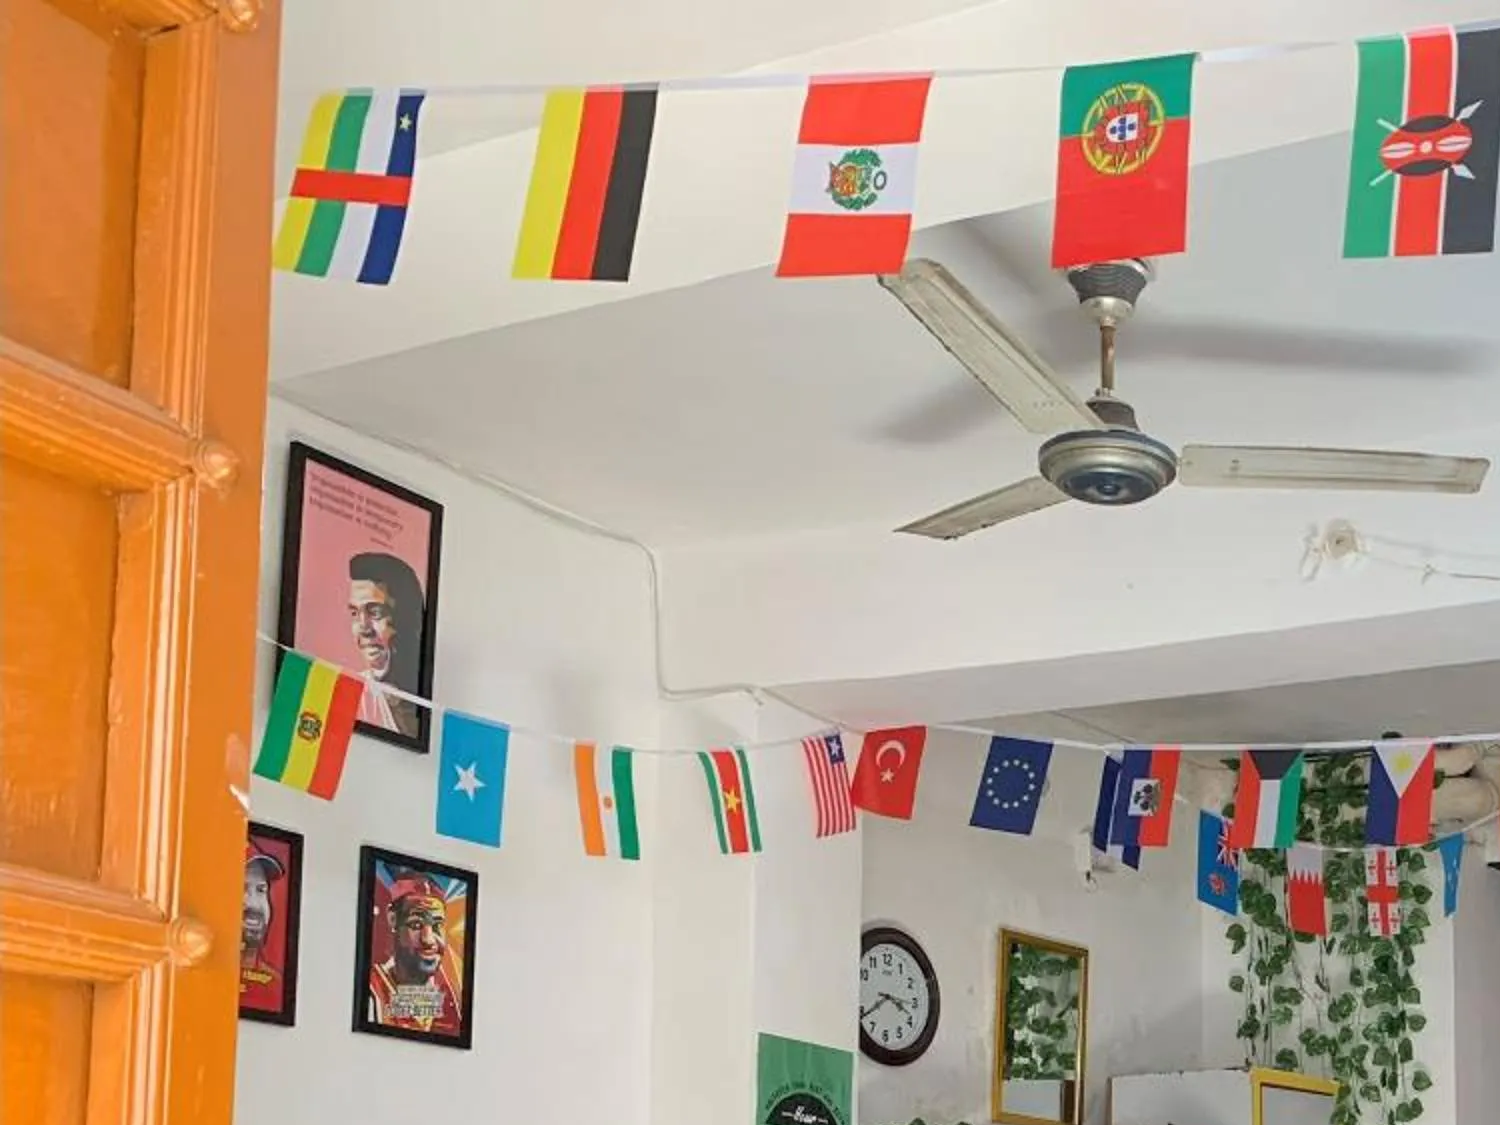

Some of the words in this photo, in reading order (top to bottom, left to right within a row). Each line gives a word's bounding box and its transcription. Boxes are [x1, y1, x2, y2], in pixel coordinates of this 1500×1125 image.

[869, 956, 877, 969] 11
[882, 953, 893, 967] 12
[907, 977, 914, 989] 2
[912, 997, 919, 1009] 3
[870, 1020, 877, 1033] 7
[896, 1026, 903, 1039] 5
